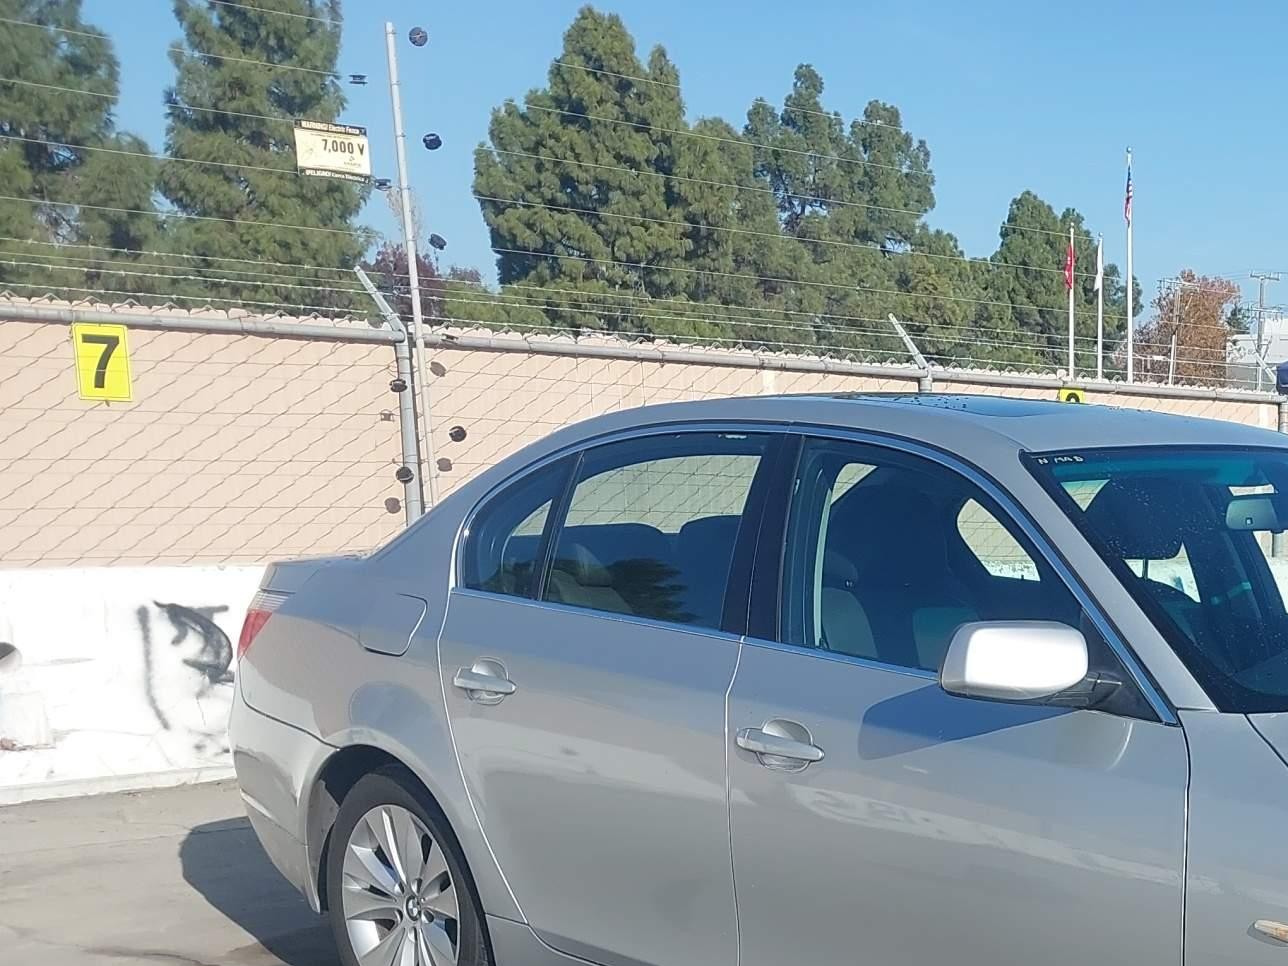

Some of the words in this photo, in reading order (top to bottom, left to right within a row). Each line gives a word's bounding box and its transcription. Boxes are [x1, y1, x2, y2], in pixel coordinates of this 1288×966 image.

[321, 138, 354, 154] 7,000
[357, 143, 364, 155] V
[81, 333, 119, 389] 7
